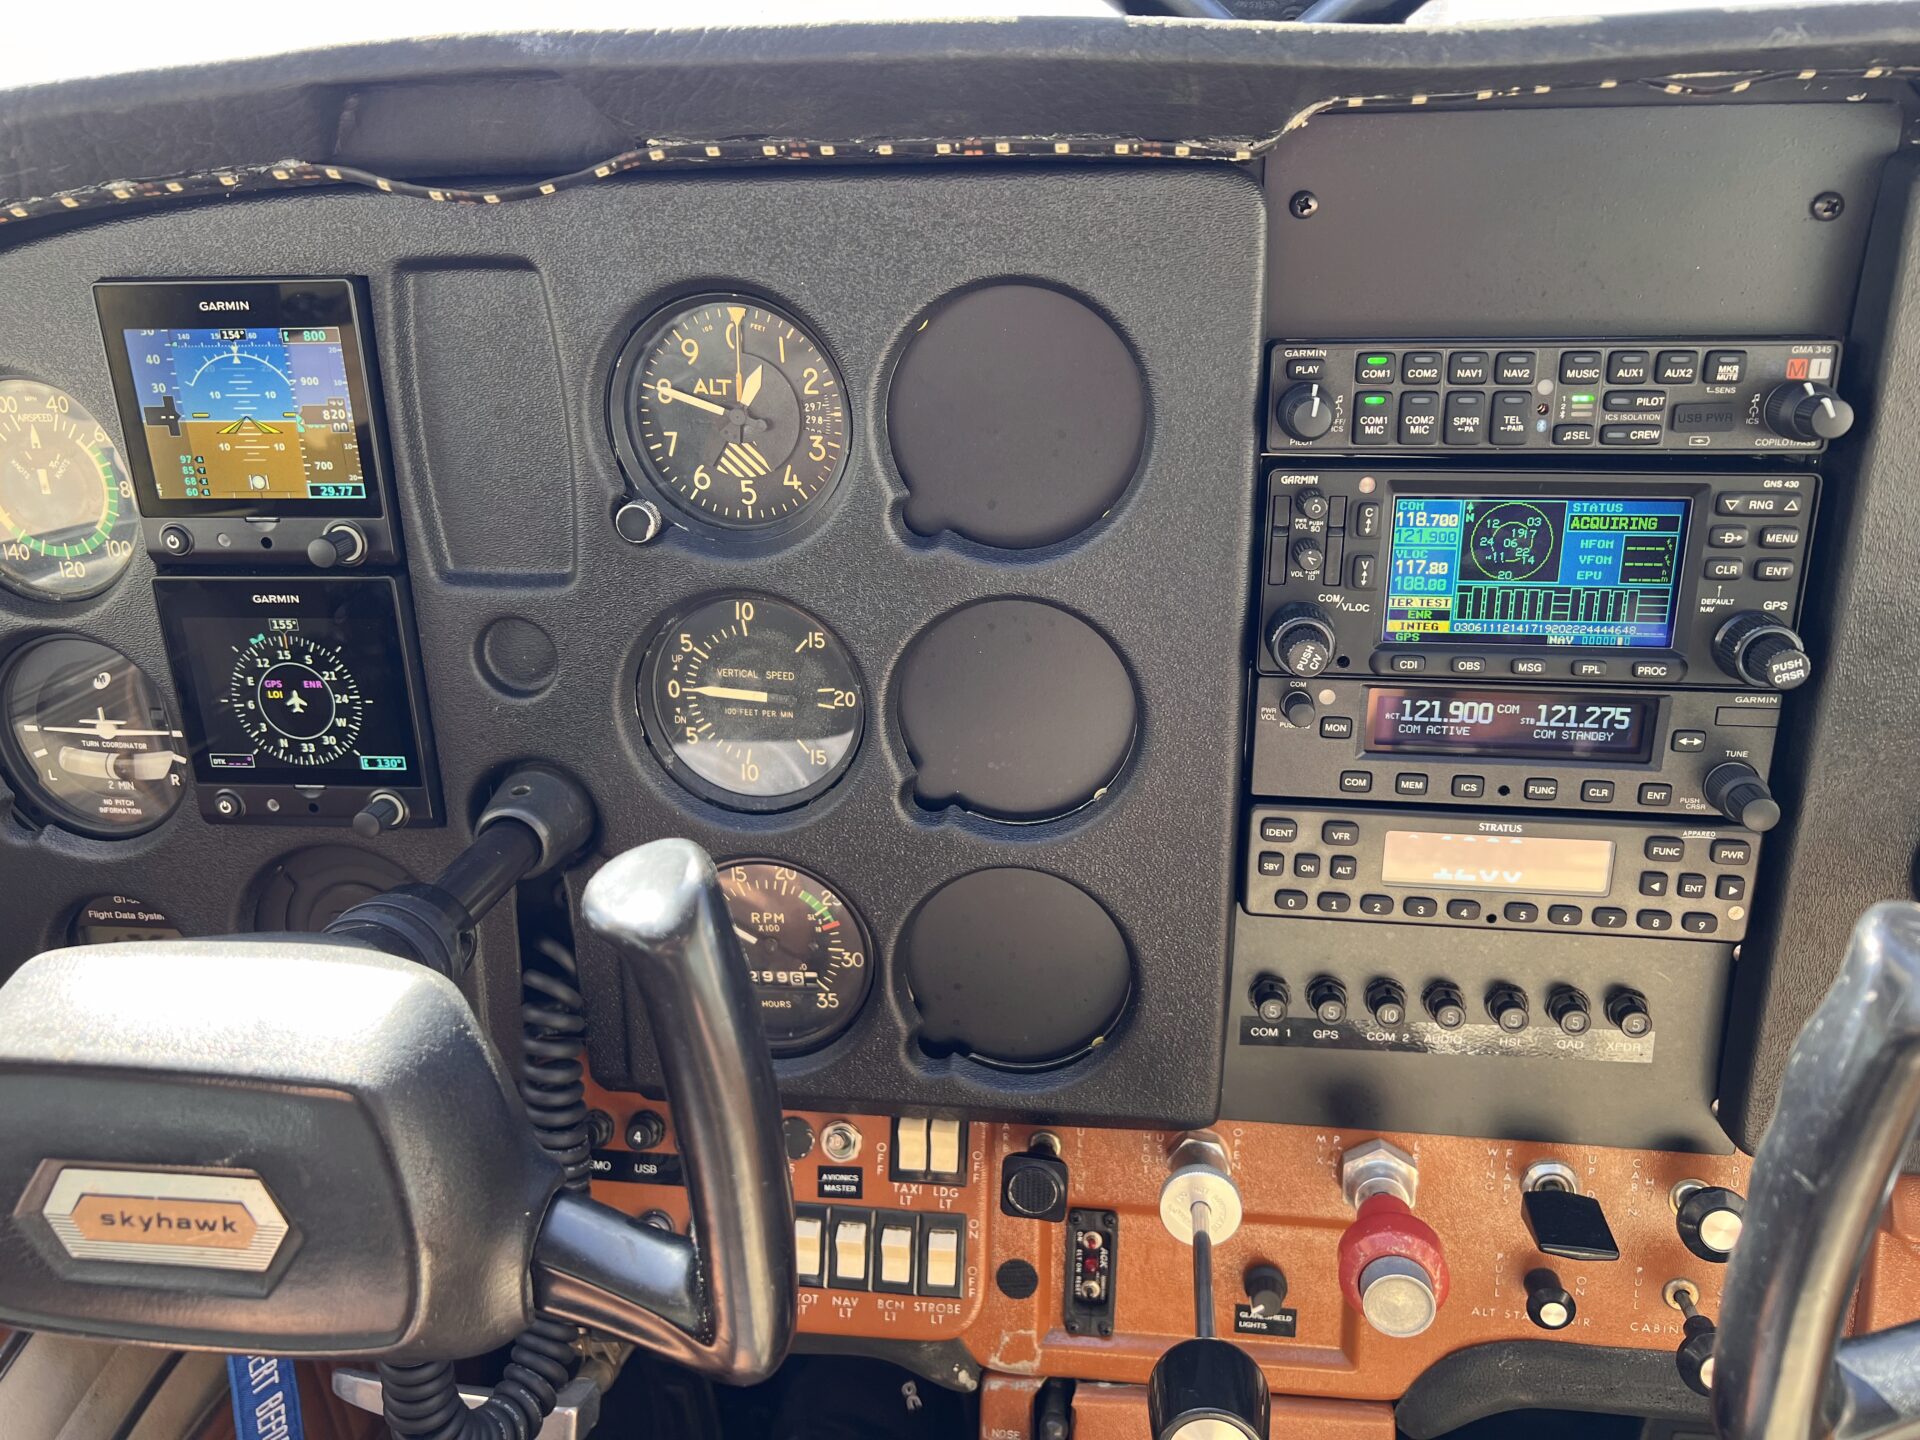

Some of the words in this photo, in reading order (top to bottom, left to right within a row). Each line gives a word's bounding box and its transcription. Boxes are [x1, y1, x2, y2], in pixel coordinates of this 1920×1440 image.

[199, 301, 249, 311] GARMIN
[222, 330, 245, 340] 154°
[303, 331, 326, 341] 800
[1792, 346, 1813, 354] GMA
[1815, 346, 1832, 354] 345
[146, 355, 160, 364] 40
[1296, 365, 1319, 374] PLAY
[1362, 369, 1391, 379] COM1
[1408, 369, 1437, 378] COM2
[1457, 369, 1482, 378] NAV1
[1503, 369, 1530, 378] NAV2
[1566, 369, 1600, 378] MUSIC
[1617, 368, 1643, 378] AUX1
[1664, 368, 1692, 378] AUX2
[1718, 365, 1739, 373] MKR
[301, 377, 319, 386] 900
[803, 368, 819, 395] 2
[1716, 373, 1738, 381] MUTE
[693, 378, 732, 395] ALT
[46, 396, 69, 413] 40
[1636, 397, 1664, 406] PILOT
[16, 414, 53, 423] AIRSPEED
[323, 410, 346, 420] 820
[1504, 415, 1522, 424] TEL
[1678, 412, 1703, 423] USB
[1706, 412, 1733, 423] PWR
[1360, 416, 1388, 425] COM1
[1405, 416, 1434, 425] COM2
[1454, 416, 1480, 426] SPKR
[1365, 426, 1384, 435] MIC
[1410, 426, 1430, 434] MIC
[1506, 424, 1524, 432] PAIR
[1630, 430, 1660, 439] CREW
[180, 455, 192, 464] 97
[314, 461, 333, 470] 700
[1280, 476, 1318, 484] GARMIN
[1764, 480, 1782, 488] GNS
[1784, 480, 1800, 488] 430
[320, 486, 353, 497] 29.77
[1400, 502, 1425, 510] COM
[1573, 503, 1623, 512] STATUS
[1748, 500, 1774, 510] RNG
[1397, 512, 1458, 527] 118.700
[1571, 517, 1658, 530] ACQUIRING
[1395, 529, 1457, 544] 121.900
[1766, 534, 1798, 544] MENU
[1580, 540, 1614, 549] HFOM
[2, 544, 30, 561] 140
[1396, 549, 1428, 559] VLOC
[59, 561, 85, 578] 120
[1396, 560, 1448, 575] 117.80
[1716, 565, 1738, 575] CLR
[1766, 566, 1788, 576] ENT
[1577, 571, 1602, 580] EPU
[1394, 577, 1447, 591] 108.00
[253, 594, 300, 603] GARMIN
[1391, 598, 1416, 607] TER
[1420, 598, 1449, 607] TEST
[736, 602, 754, 620] 10
[1763, 601, 1788, 611] GPS
[1407, 610, 1432, 619] ENR
[272, 620, 297, 630] 155°
[1400, 622, 1439, 631] INTEG
[808, 632, 825, 648] 15
[1396, 633, 1420, 642] GPS
[277, 650, 291, 660] 15
[671, 655, 683, 663] UP
[1399, 660, 1418, 670] CDI
[1458, 661, 1480, 671] OBS
[1518, 662, 1542, 672] MSG
[1582, 664, 1600, 674] FPL
[1772, 658, 1803, 674] PUSH
[717, 668, 758, 679] VERTICAL
[766, 671, 795, 680] SPEED
[1638, 666, 1667, 676] PROC
[1774, 669, 1805, 684] CRSR
[265, 680, 282, 689] GPS
[304, 680, 322, 689] ENR
[267, 690, 283, 699] LOI
[335, 694, 349, 704] 24
[834, 692, 855, 707] 20
[1735, 696, 1778, 704] GARMIN
[739, 709, 758, 717] FEET
[1400, 700, 1494, 724] 121.900
[674, 716, 686, 724] DN
[1535, 705, 1631, 730] 121.275
[1325, 724, 1347, 732] MON
[1398, 725, 1420, 734] COM
[1426, 726, 1470, 736] ACTIVE
[1534, 729, 1556, 739] COM
[1562, 731, 1614, 741] STANDBY
[82, 740, 100, 749] TURN
[102, 741, 147, 750] COORDINATOR
[1726, 750, 1749, 758] TUNE
[376, 758, 402, 768] 130°
[48, 770, 58, 780] L
[170, 774, 180, 786] R
[108, 781, 115, 789] 2
[1344, 778, 1366, 786] COM
[1401, 781, 1423, 789] MEM
[1461, 783, 1477, 792] ICS
[1529, 786, 1555, 795] FUNC
[1589, 789, 1608, 797] CLR
[1647, 791, 1667, 800] ENT
[103, 798, 113, 806] NO
[115, 799, 134, 807] PITCH
[99, 806, 142, 815] INFORMATION
[1266, 828, 1293, 837] IDENT
[1479, 822, 1522, 833] STRATUS
[1332, 832, 1350, 840] VFR
[1653, 846, 1680, 856] FUNC
[1721, 850, 1744, 860] PWR
[1264, 863, 1279, 871] SBY
[1301, 864, 1314, 872] ON
[1336, 866, 1352, 875] ALT
[1685, 884, 1703, 893] ENT
[88, 910, 113, 919] Flight
[115, 911, 136, 919] Data
[751, 912, 785, 923] RPM
[842, 953, 864, 967] 30
[762, 1000, 792, 1008] HOURS
[817, 993, 839, 1008] 35
[1251, 1027, 1278, 1037] COM
[1286, 1029, 1291, 1037] 1
[1313, 1030, 1339, 1039] GPS
[1366, 1032, 1395, 1041] COM
[1402, 1033, 1409, 1042] 2
[634, 1163, 657, 1174] USB
[822, 1174, 859, 1182] AVIONICS
[824, 1184, 857, 1192] MASTER
[893, 1183, 923, 1195] TAXI
[933, 1187, 959, 1198] LDG
[100, 1211, 239, 1233] skyhawk
[832, 1296, 859, 1307] NAV
[878, 1299, 905, 1310] BCN
[914, 1303, 961, 1314] STROBE
[1471, 1306, 1496, 1316] ALT
[1239, 1321, 1267, 1330] LIGHTS
[1630, 1322, 1679, 1334] CABIN
